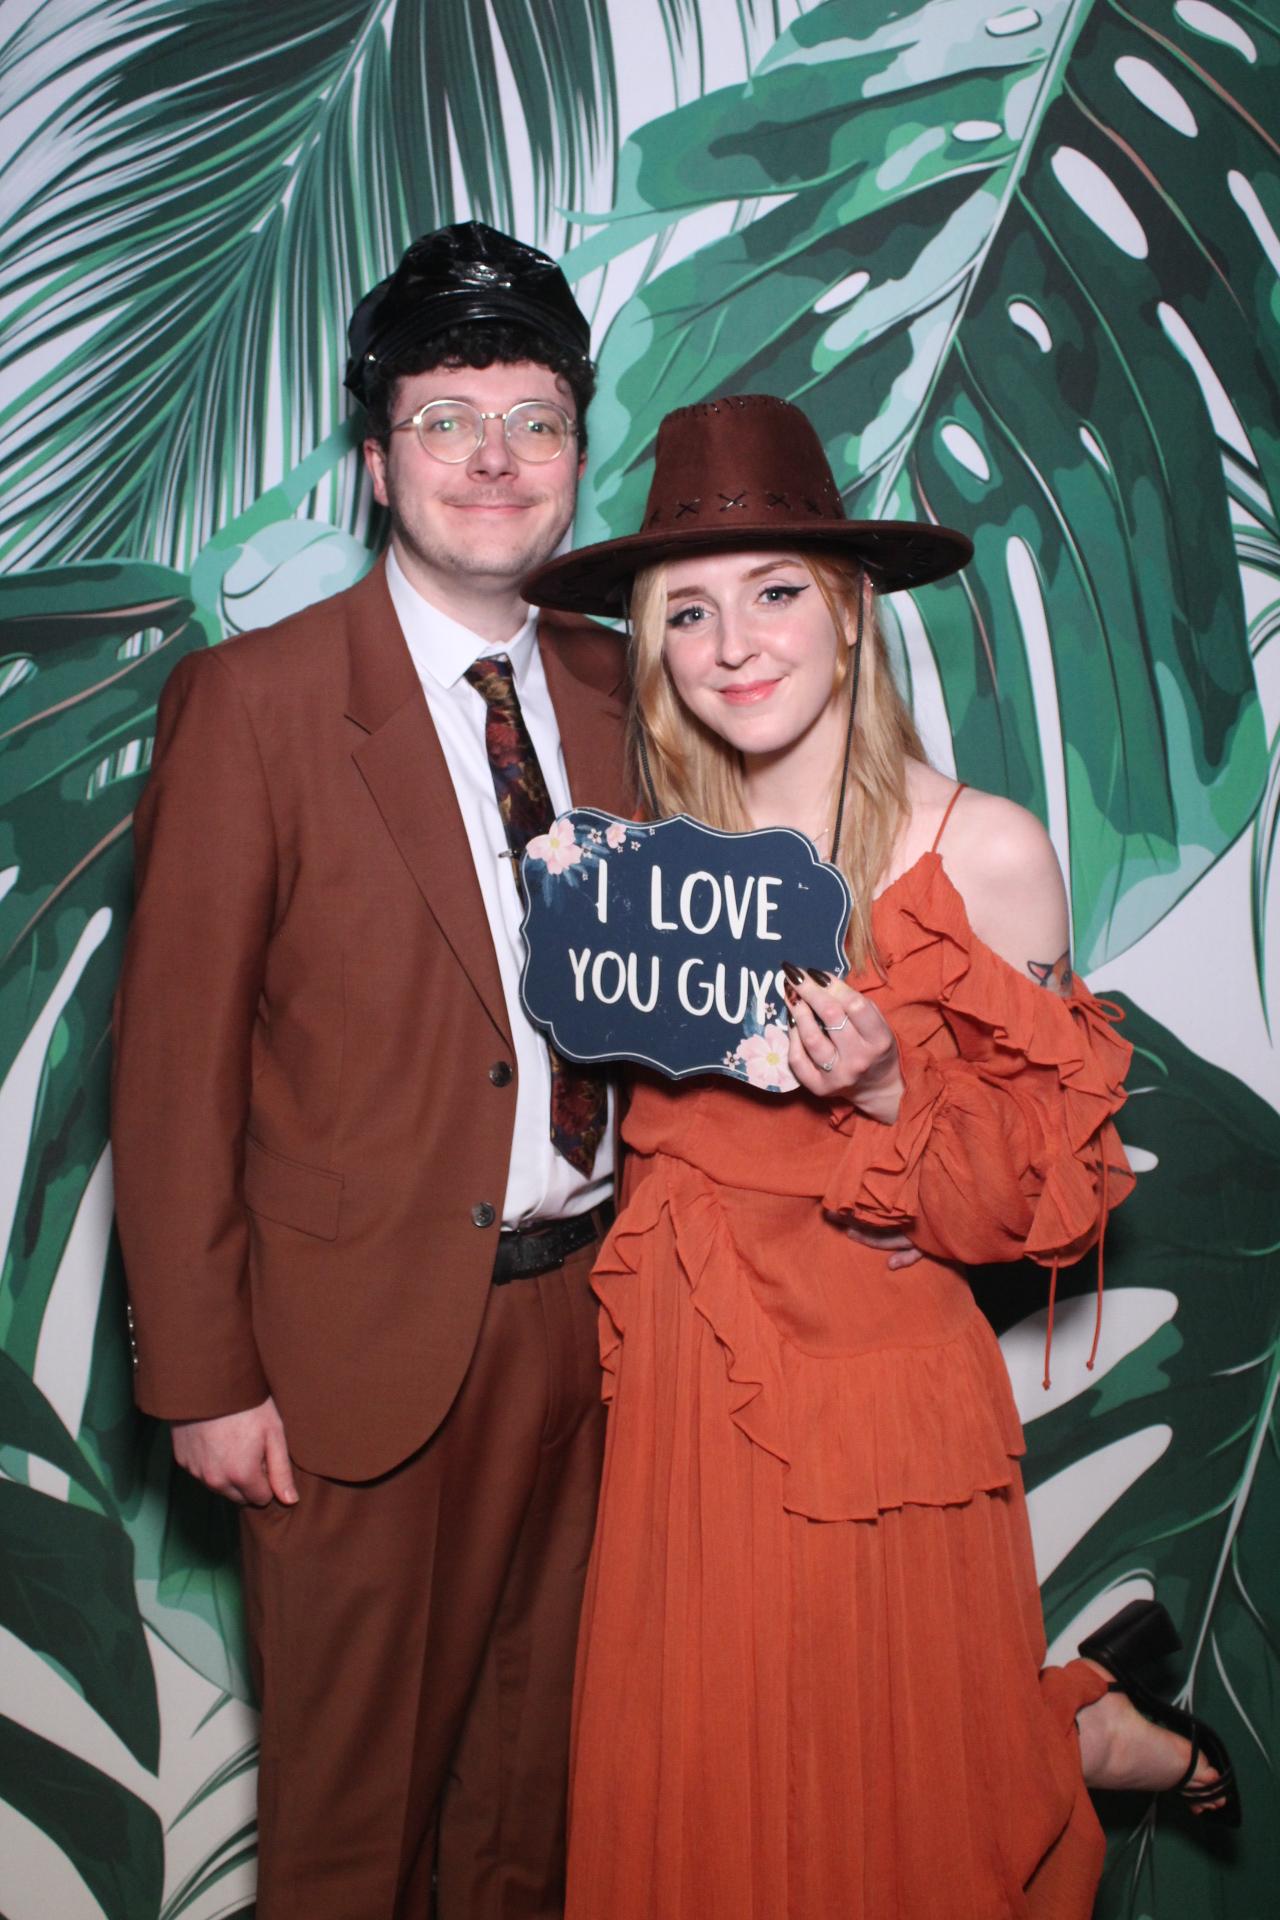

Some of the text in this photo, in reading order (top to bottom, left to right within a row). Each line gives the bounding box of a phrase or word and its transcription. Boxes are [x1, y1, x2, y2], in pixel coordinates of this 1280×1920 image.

[597, 858, 782, 940] I LOVE
[568, 948, 660, 1012] YOU
